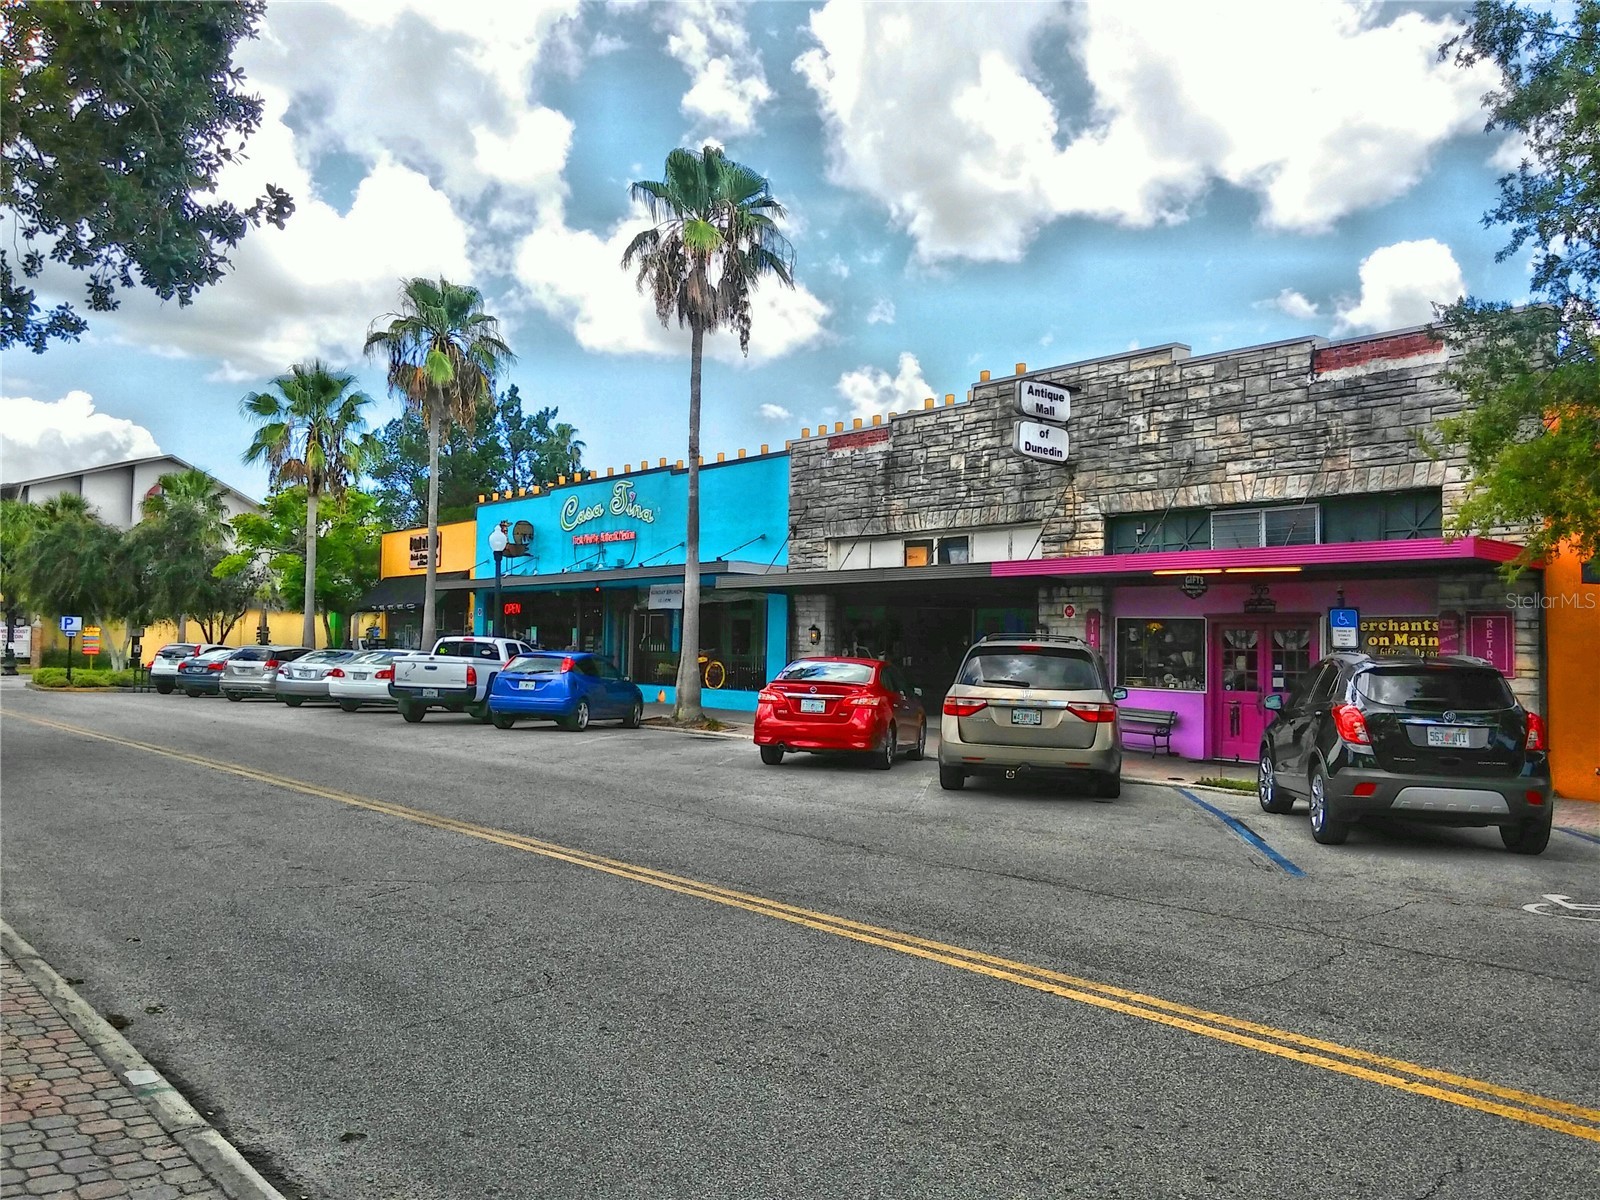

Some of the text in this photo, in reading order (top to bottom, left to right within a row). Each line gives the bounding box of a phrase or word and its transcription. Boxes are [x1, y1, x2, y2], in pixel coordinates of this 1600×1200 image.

[1027, 385, 1065, 402] Antique
[1035, 403, 1055, 416] Mall
[1039, 429, 1050, 438] of
[1025, 441, 1063, 457] Dunedin
[560, 480, 655, 531] Casa Tina
[1185, 576, 1204, 584] GIFTS
[504, 603, 521, 615] OPEN
[64, 617, 74, 629] P
[1360, 619, 1439, 632] erchants
[1368, 636, 1390, 646] on
[1394, 634, 1439, 646] Main
